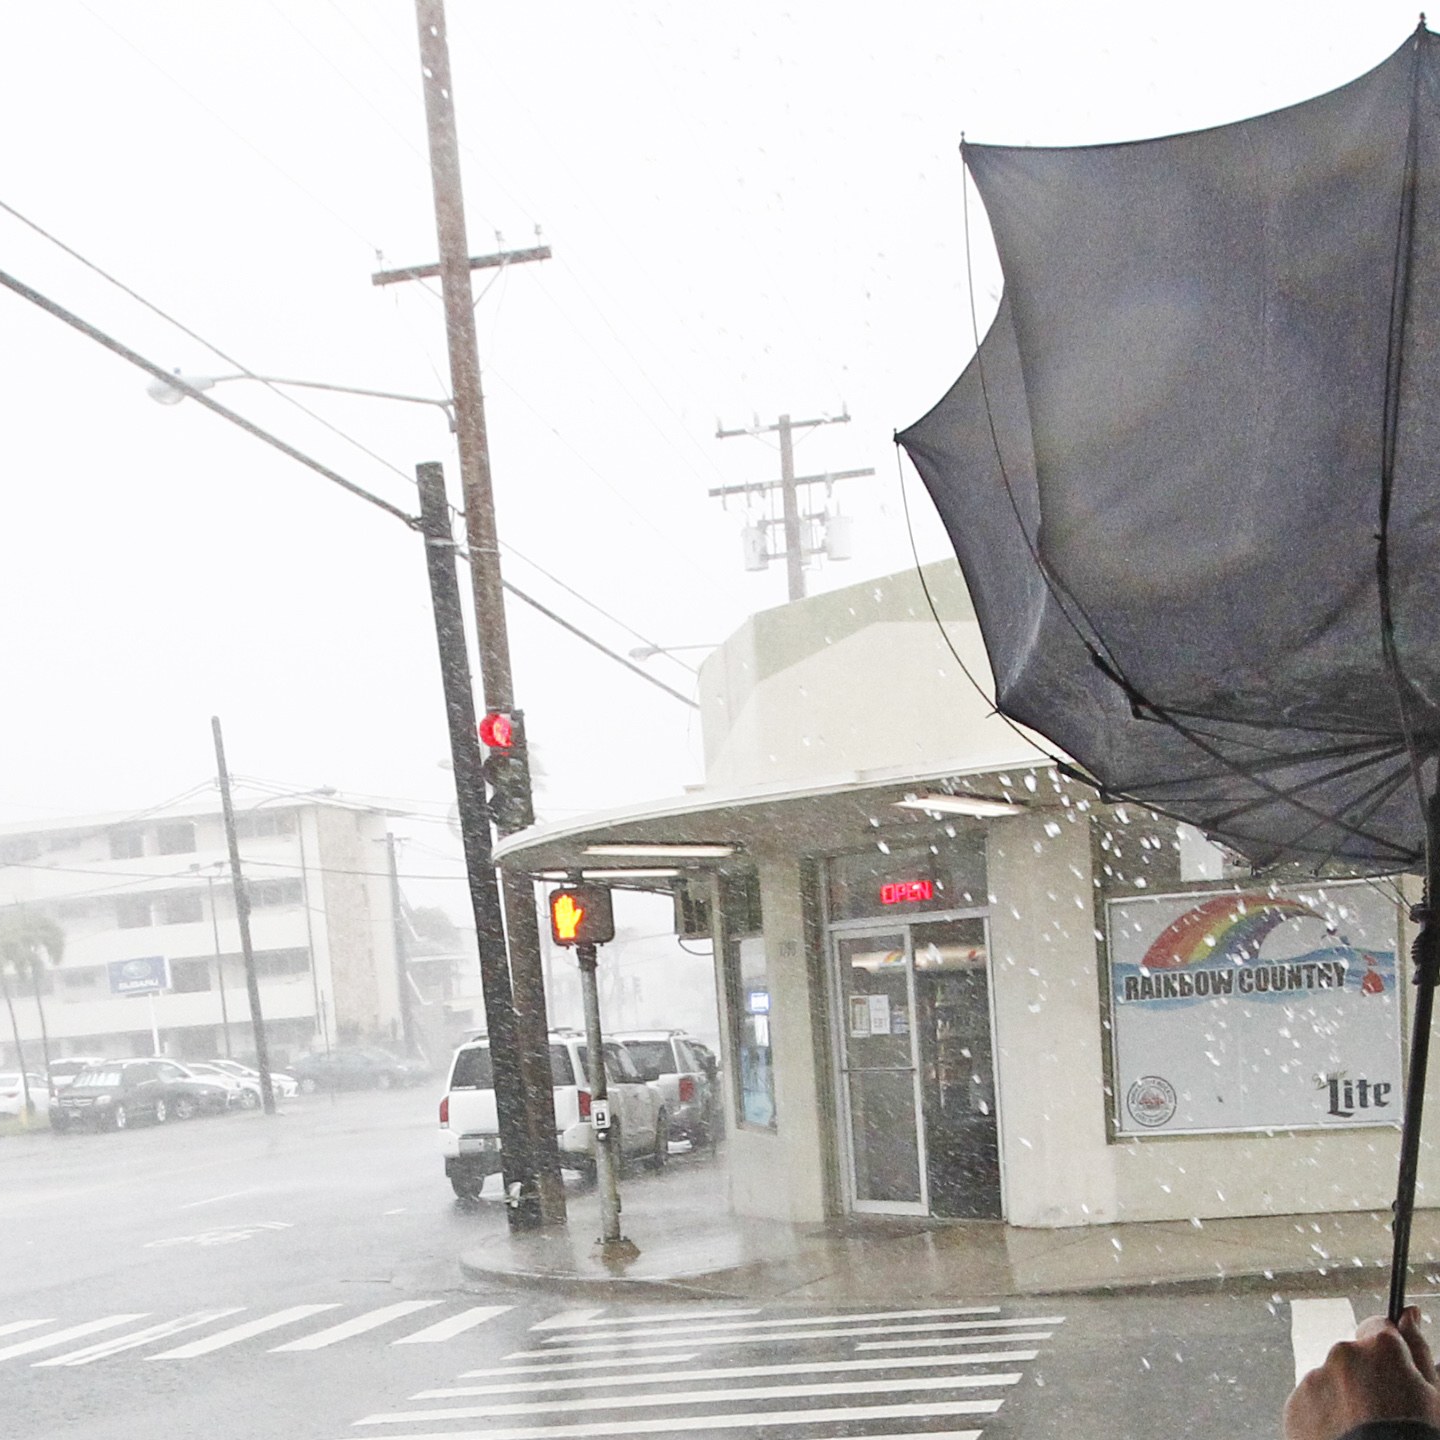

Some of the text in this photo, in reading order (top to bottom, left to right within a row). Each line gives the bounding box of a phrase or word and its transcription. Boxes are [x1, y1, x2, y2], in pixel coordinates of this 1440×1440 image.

[881, 880, 933, 904] OPEN
[1124, 962, 1347, 1001] RAINBOW COUNTRY
[1326, 1077, 1392, 1118] Lite
